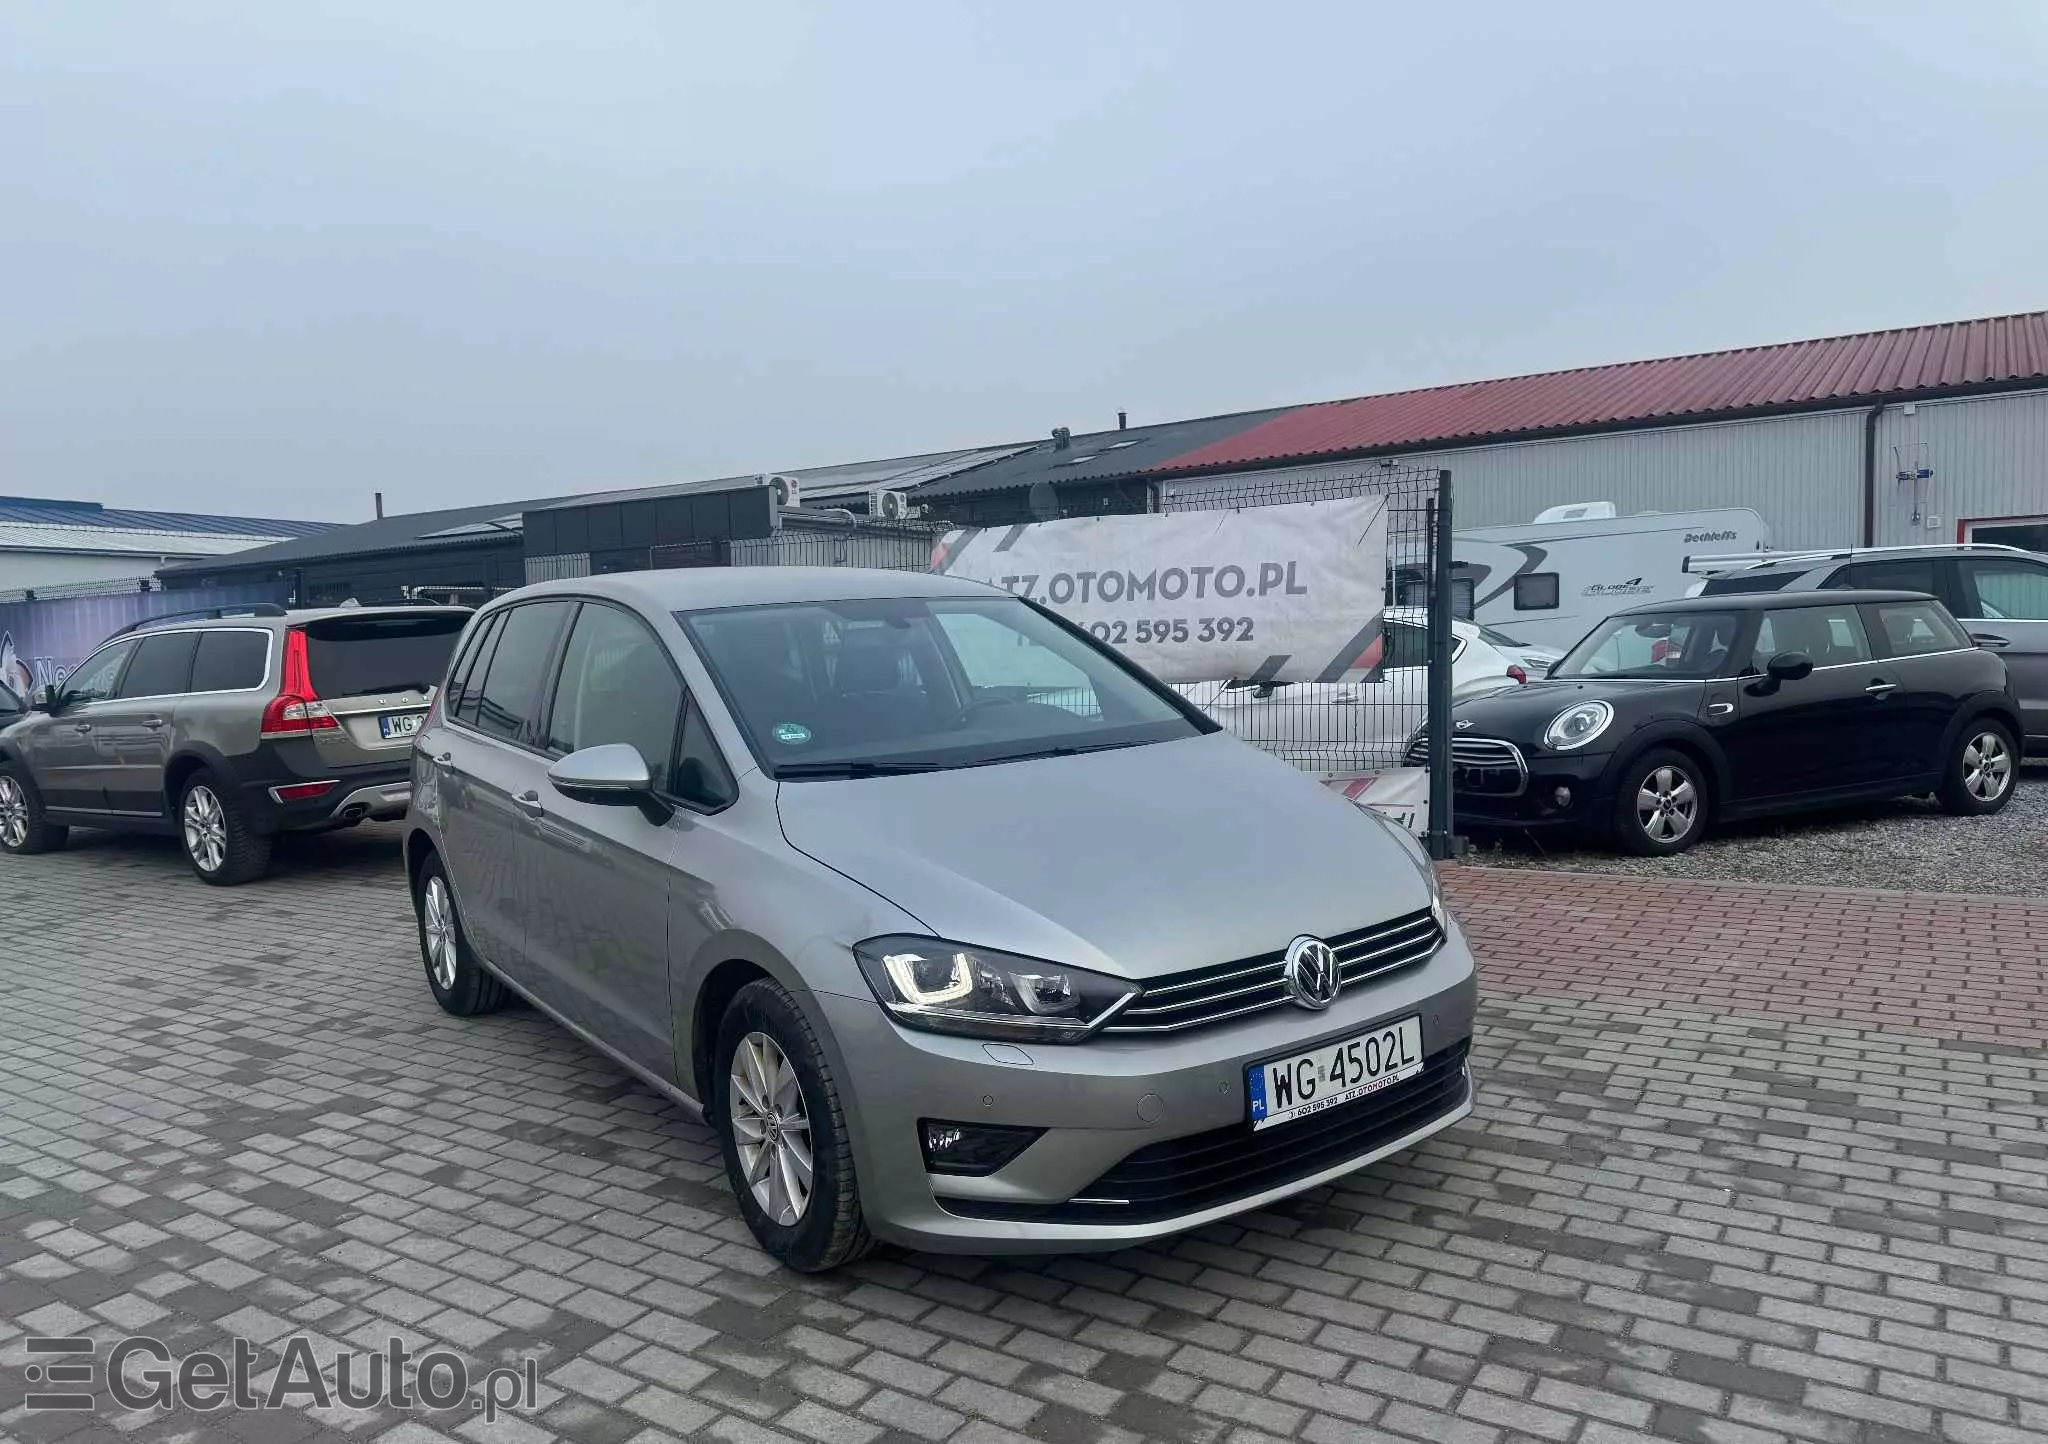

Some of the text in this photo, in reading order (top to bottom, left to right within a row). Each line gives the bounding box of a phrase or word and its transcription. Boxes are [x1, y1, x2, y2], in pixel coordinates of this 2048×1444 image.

[988, 560, 1308, 604] TZ.OTOMOTO.PL
[1135, 619, 1189, 643] 595
[1197, 617, 1254, 642] 392
[392, 716, 413, 733] WG
[1272, 1026, 1415, 1109] WG 4502L
[1252, 1100, 1265, 1111] PL
[1297, 1097, 1338, 1116] 602 595 392
